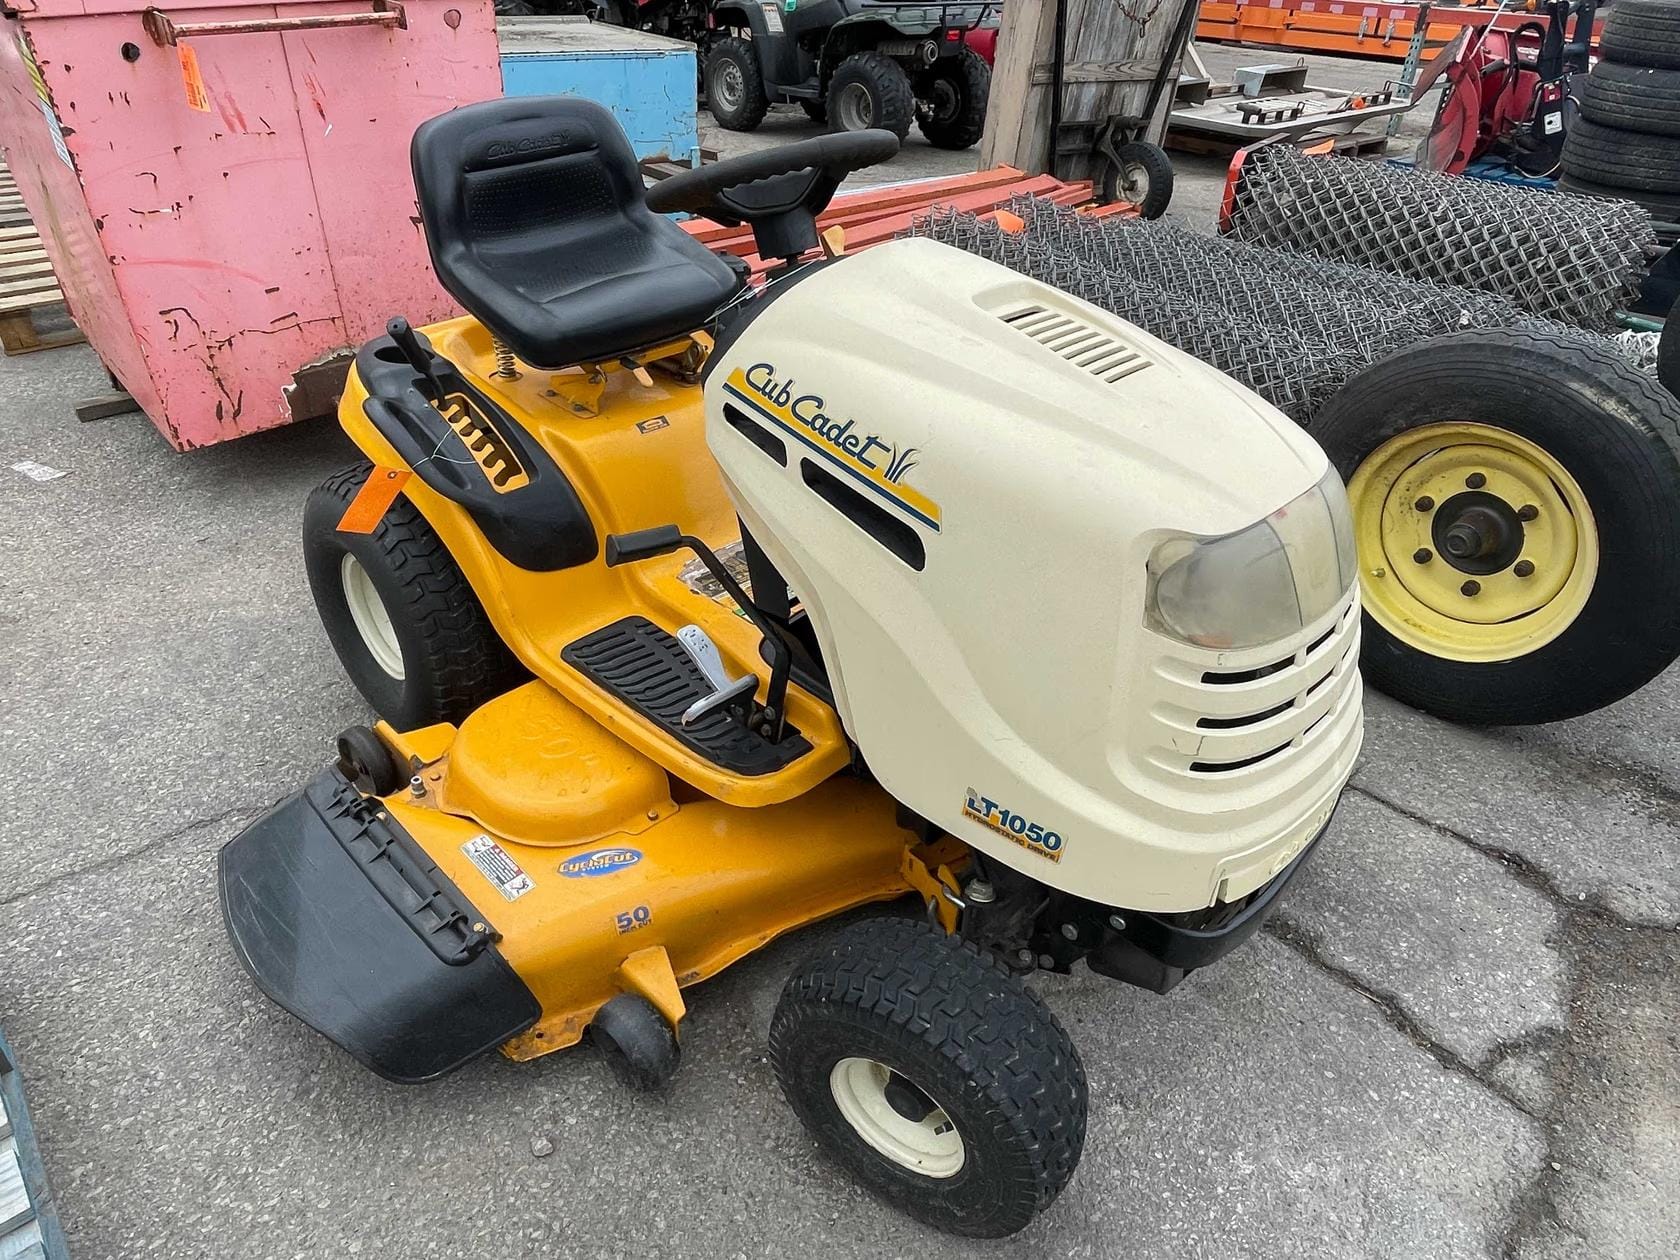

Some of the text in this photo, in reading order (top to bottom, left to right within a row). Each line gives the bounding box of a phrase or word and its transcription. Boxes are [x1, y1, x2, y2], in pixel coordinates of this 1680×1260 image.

[745, 363, 892, 471] Cub Cadet
[966, 796, 1062, 851] LT1050
[616, 905, 650, 930] 50
